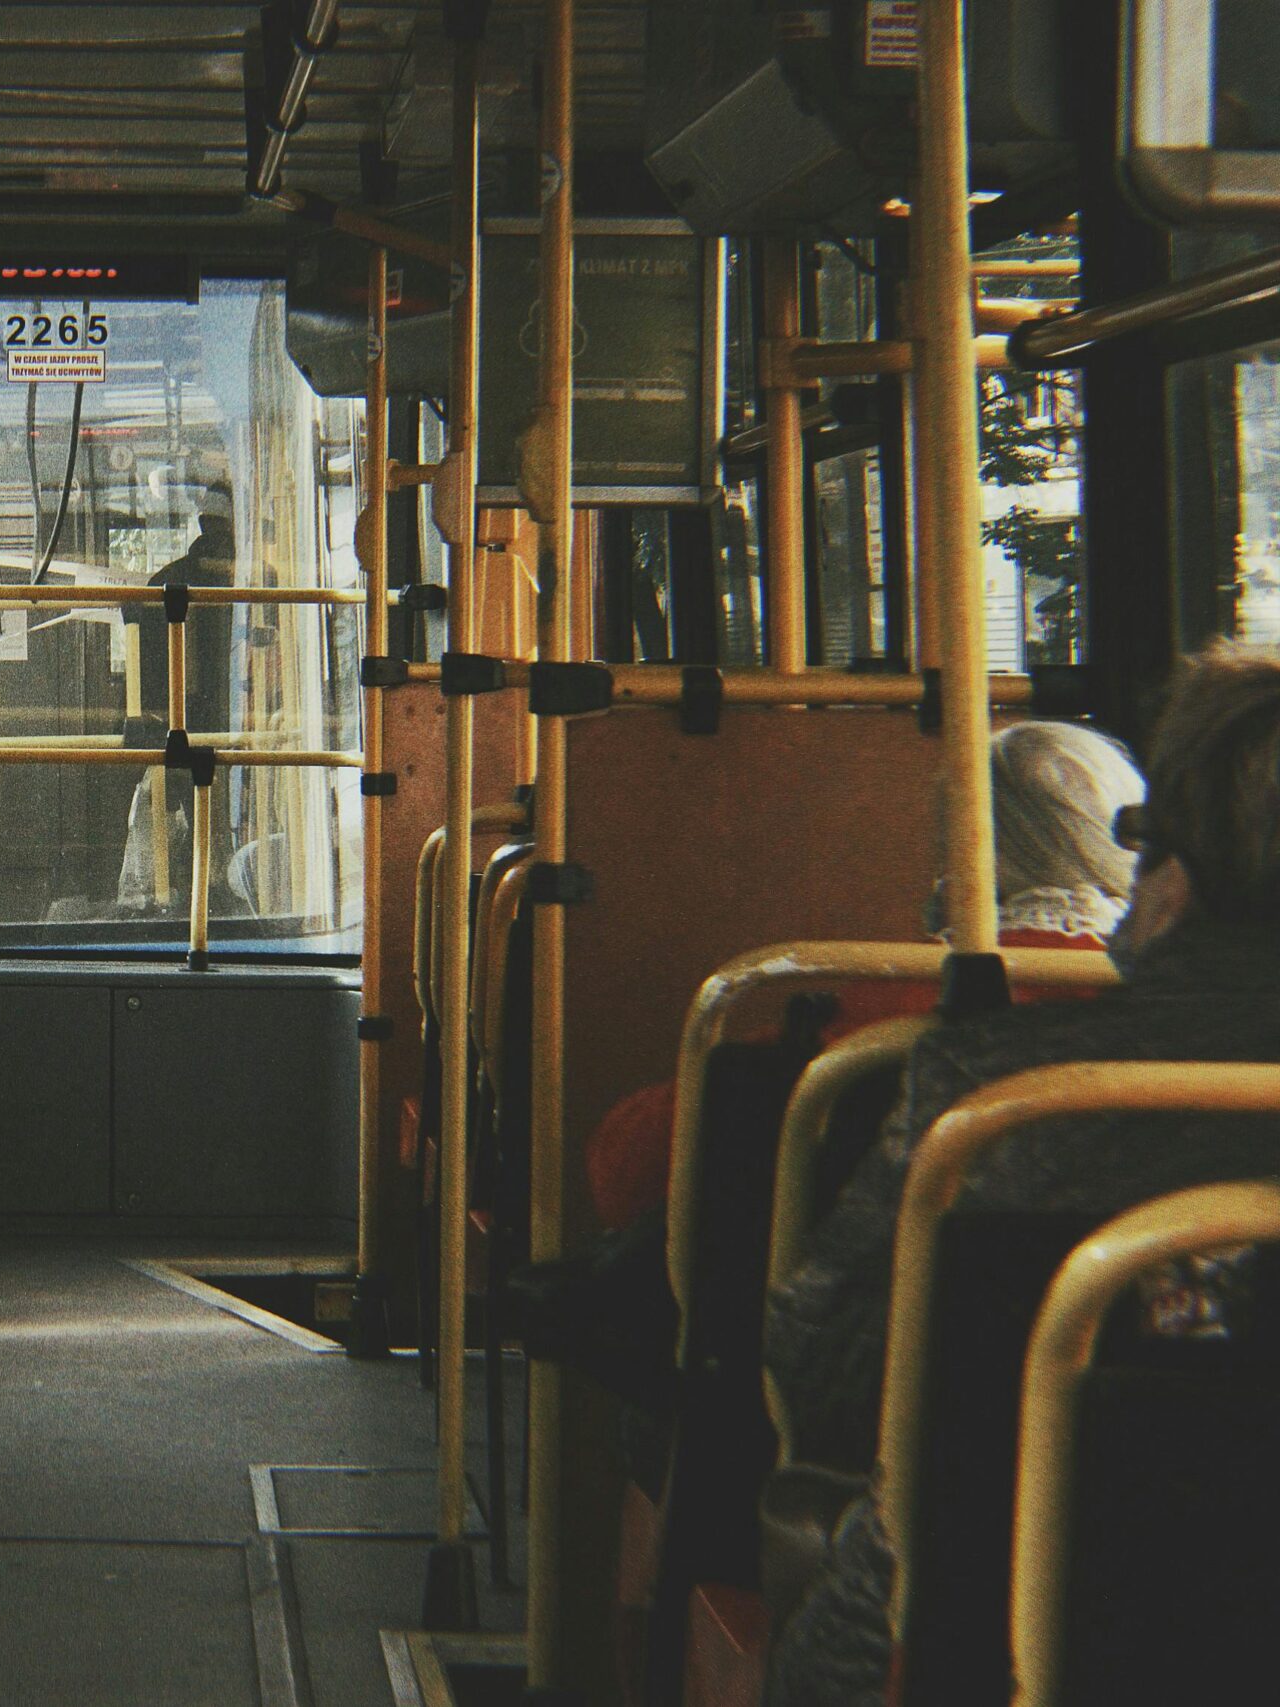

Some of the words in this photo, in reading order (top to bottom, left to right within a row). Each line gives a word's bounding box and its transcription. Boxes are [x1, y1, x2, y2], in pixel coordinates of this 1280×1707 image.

[6, 315, 108, 346] 2265
[14, 355, 22, 364] W
[23, 355, 49, 364] CZASIE
[50, 355, 71, 364] JAZDY
[72, 355, 99, 365] PROSZĘ
[12, 366, 45, 376] TRZYMAĆ
[45, 367, 58, 377] SIĘ
[58, 366, 102, 376] UCHWYTÓW
